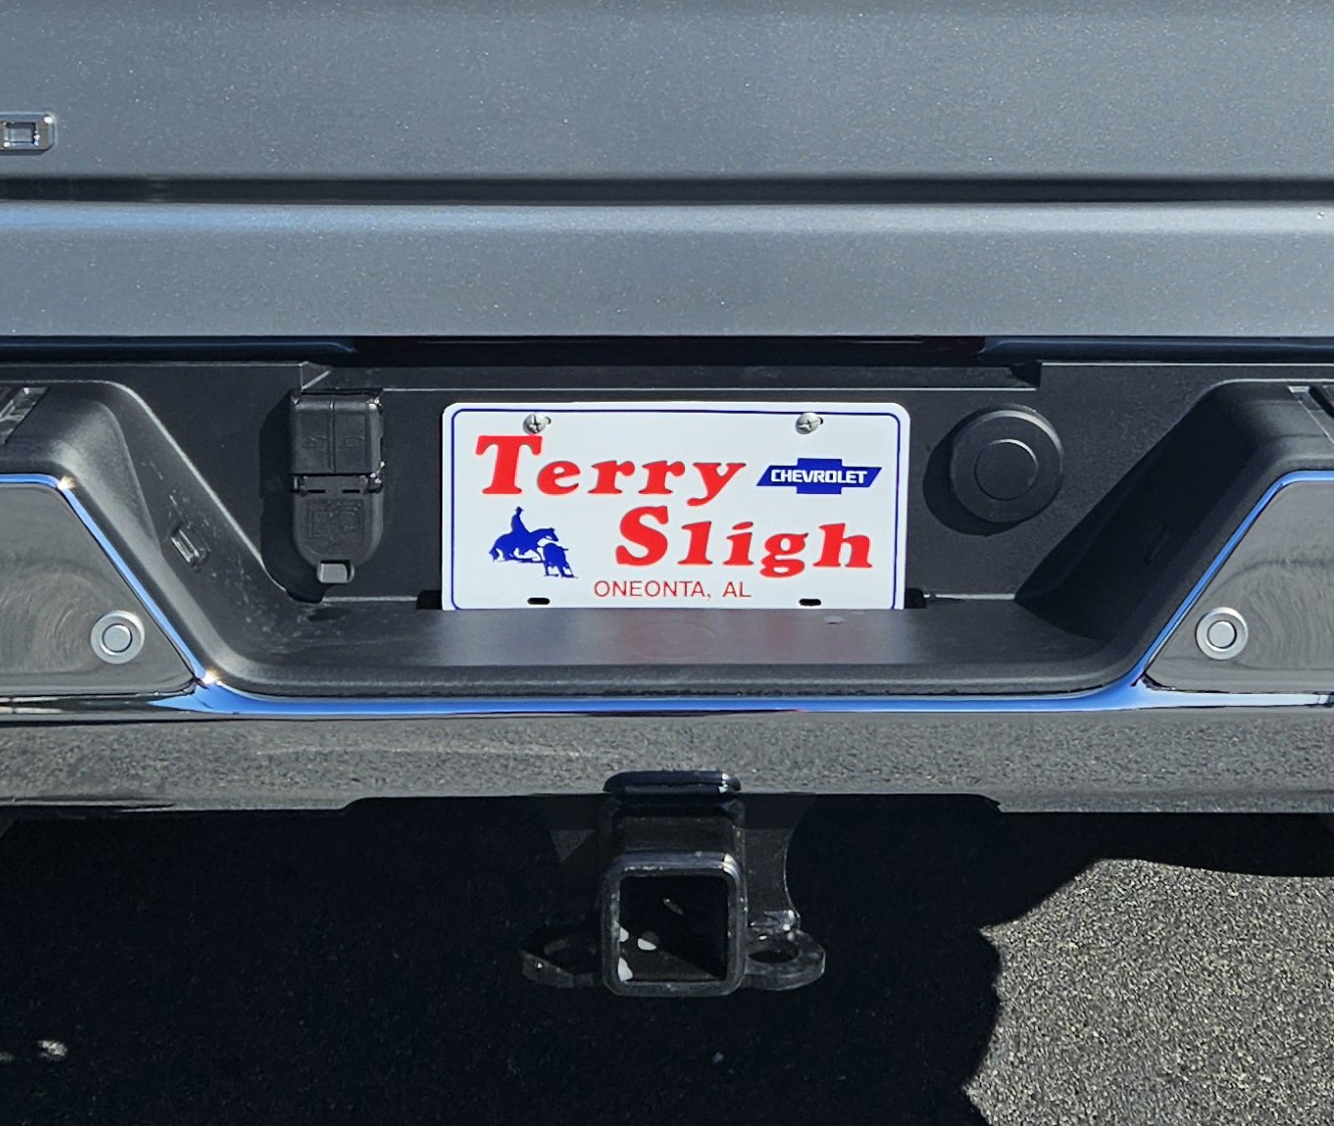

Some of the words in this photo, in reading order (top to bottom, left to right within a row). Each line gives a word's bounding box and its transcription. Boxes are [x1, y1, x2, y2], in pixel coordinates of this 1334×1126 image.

[475, 435, 747, 506] Terry
[770, 468, 868, 485] CHEVROLET
[616, 505, 873, 578] Sligh
[594, 580, 711, 599] ONEONTA,
[722, 580, 752, 598] AL
